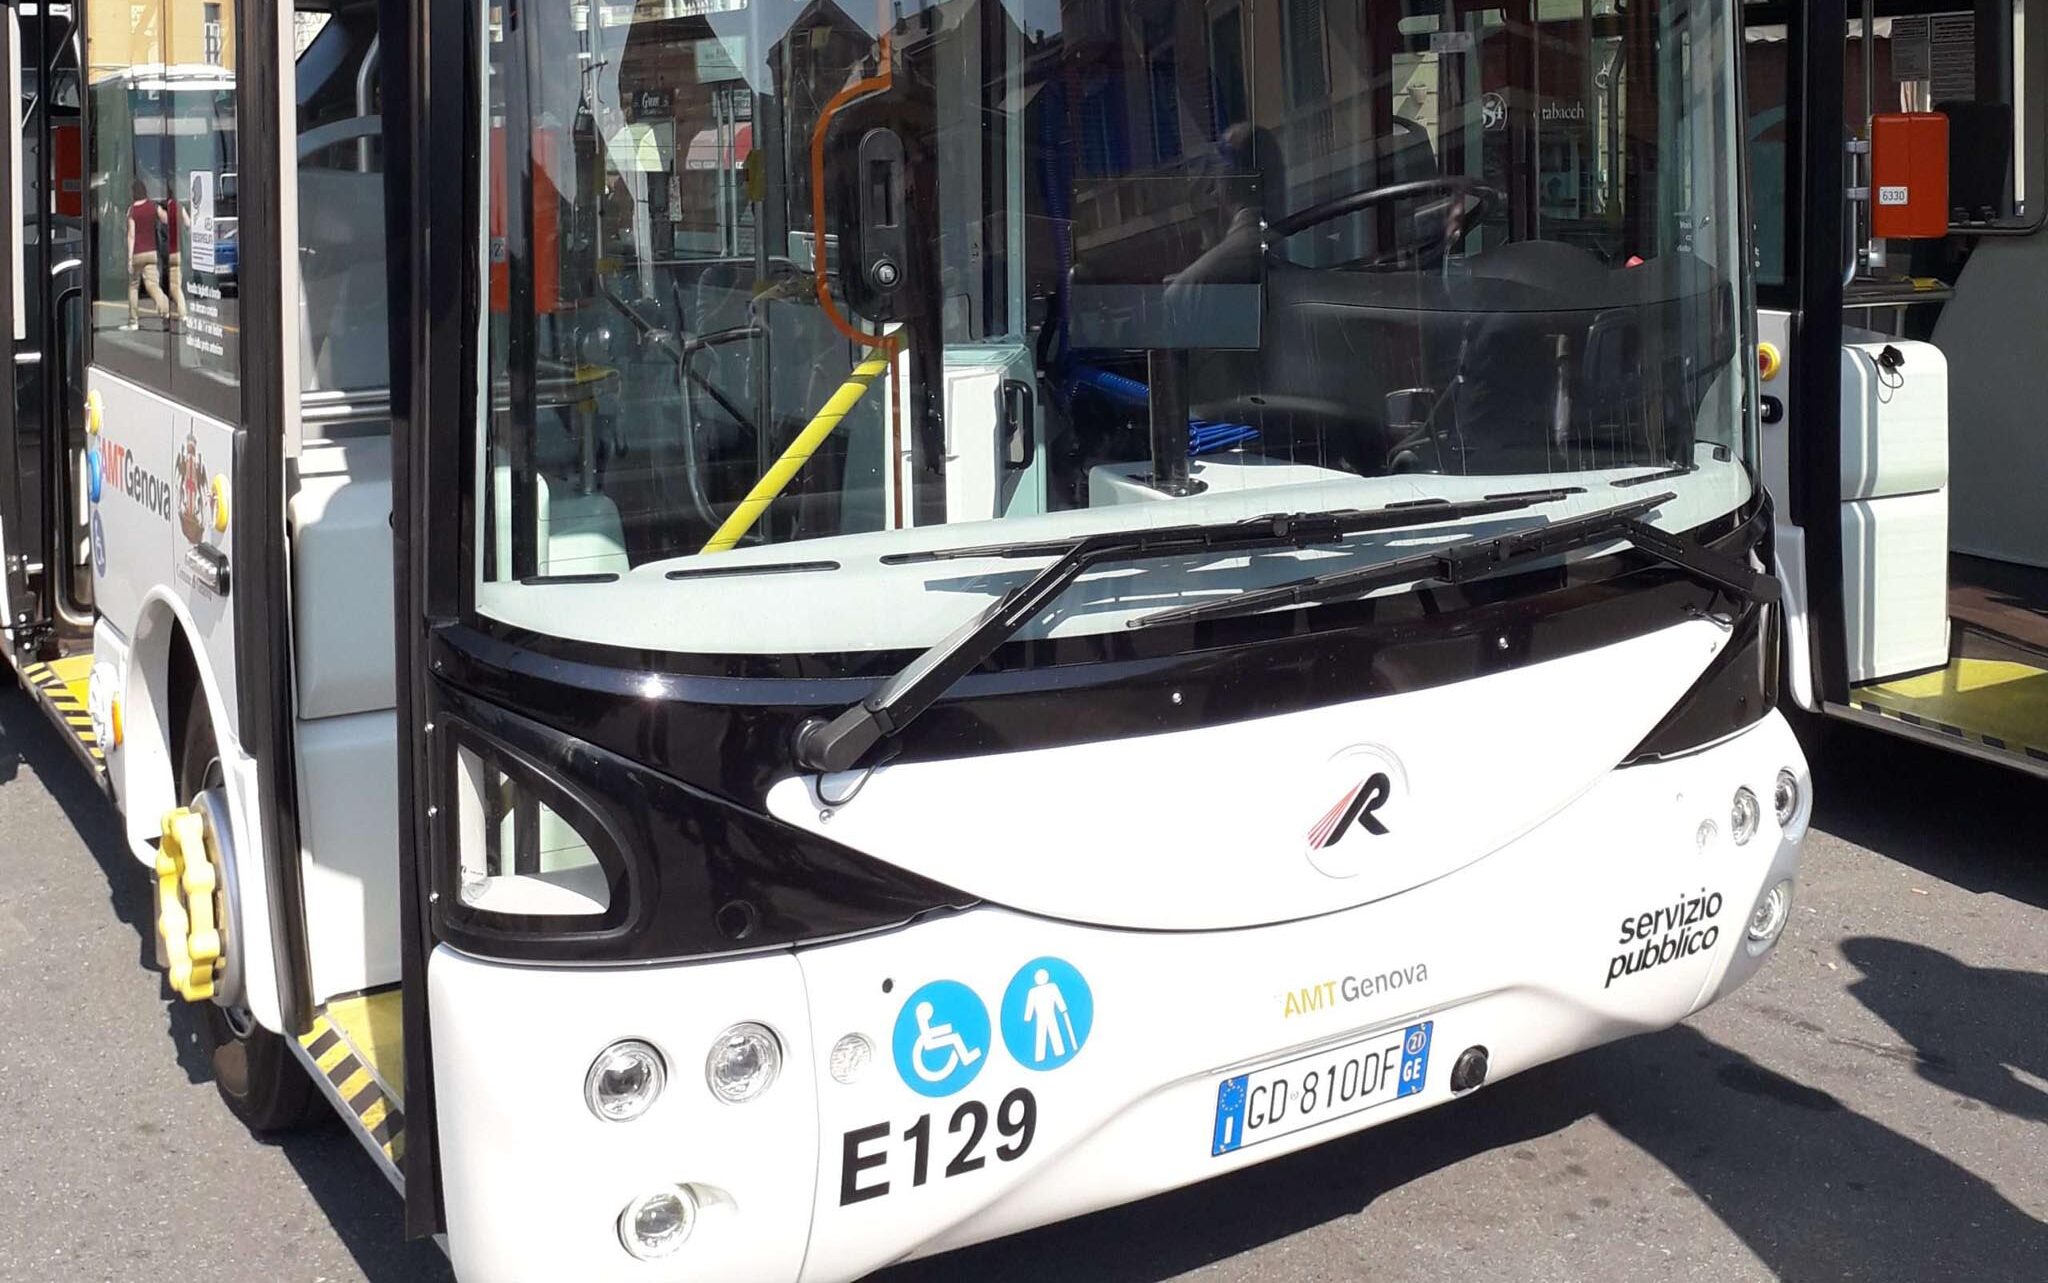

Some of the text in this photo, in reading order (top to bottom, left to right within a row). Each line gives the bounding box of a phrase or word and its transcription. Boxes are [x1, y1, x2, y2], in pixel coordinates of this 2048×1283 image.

[1882, 190, 1905, 201] 6330
[1618, 886, 1723, 945] servizio
[1604, 925, 1719, 989] pubblico
[1403, 1057, 1422, 1082] GE
[839, 1086, 1037, 1207] E129
